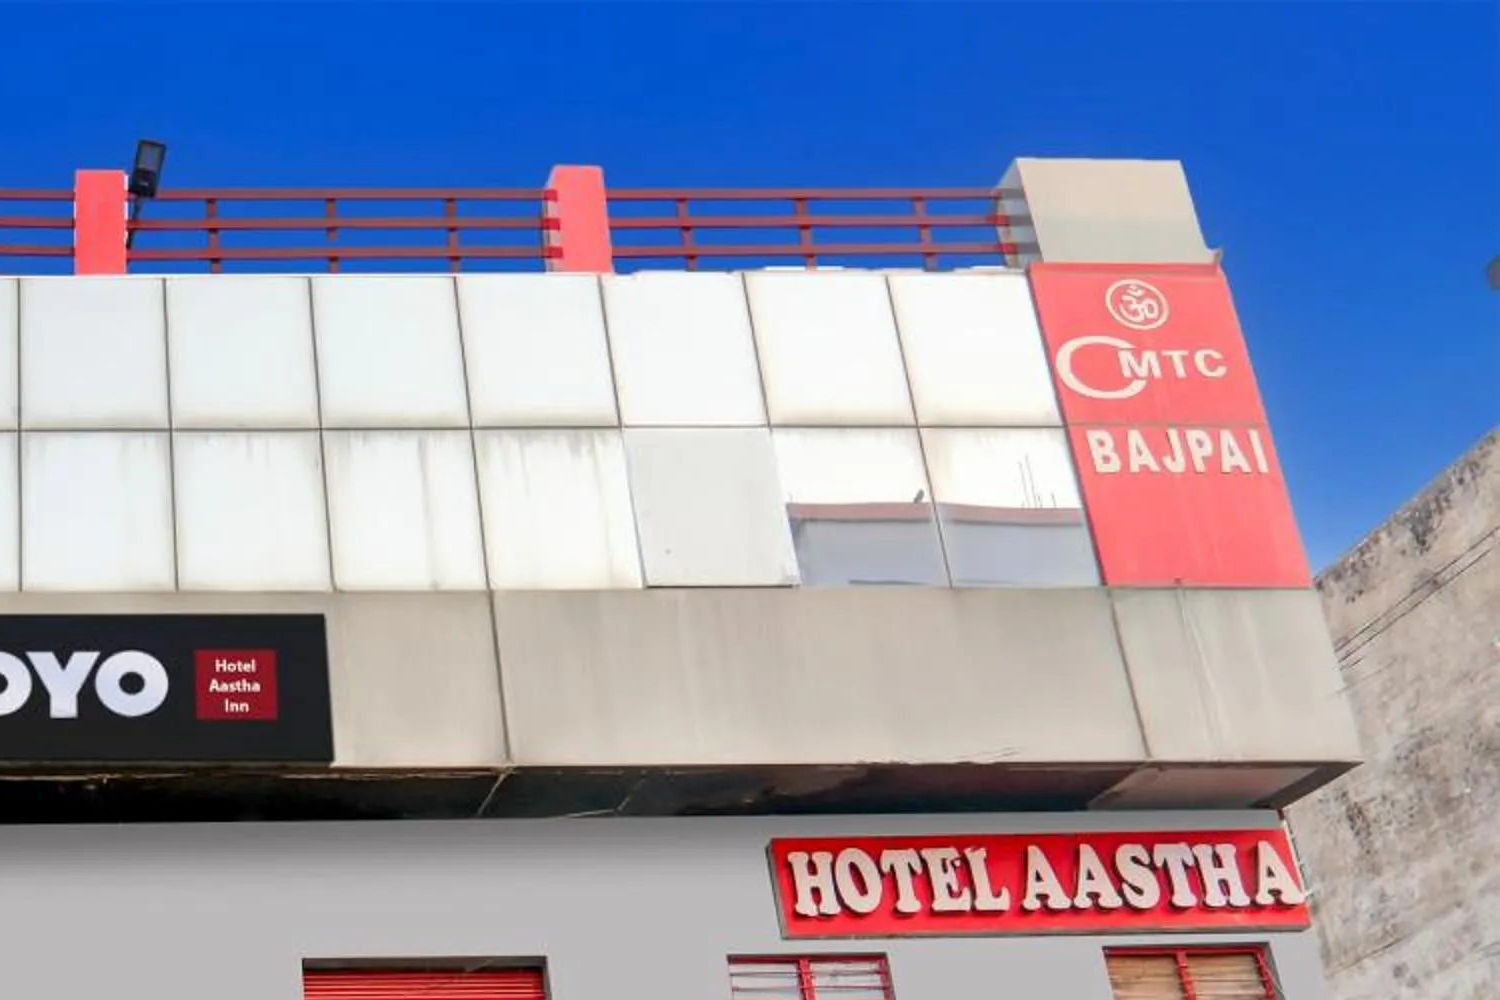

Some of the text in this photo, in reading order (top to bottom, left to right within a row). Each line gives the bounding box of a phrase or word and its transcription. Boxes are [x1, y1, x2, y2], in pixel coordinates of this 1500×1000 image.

[1086, 428, 1269, 474] BAJPAI
[215, 658, 256, 674] Hotel
[208, 678, 261, 693] Aastha
[224, 699, 250, 713] Inn
[788, 840, 1301, 918] HOTEL AASTHA
